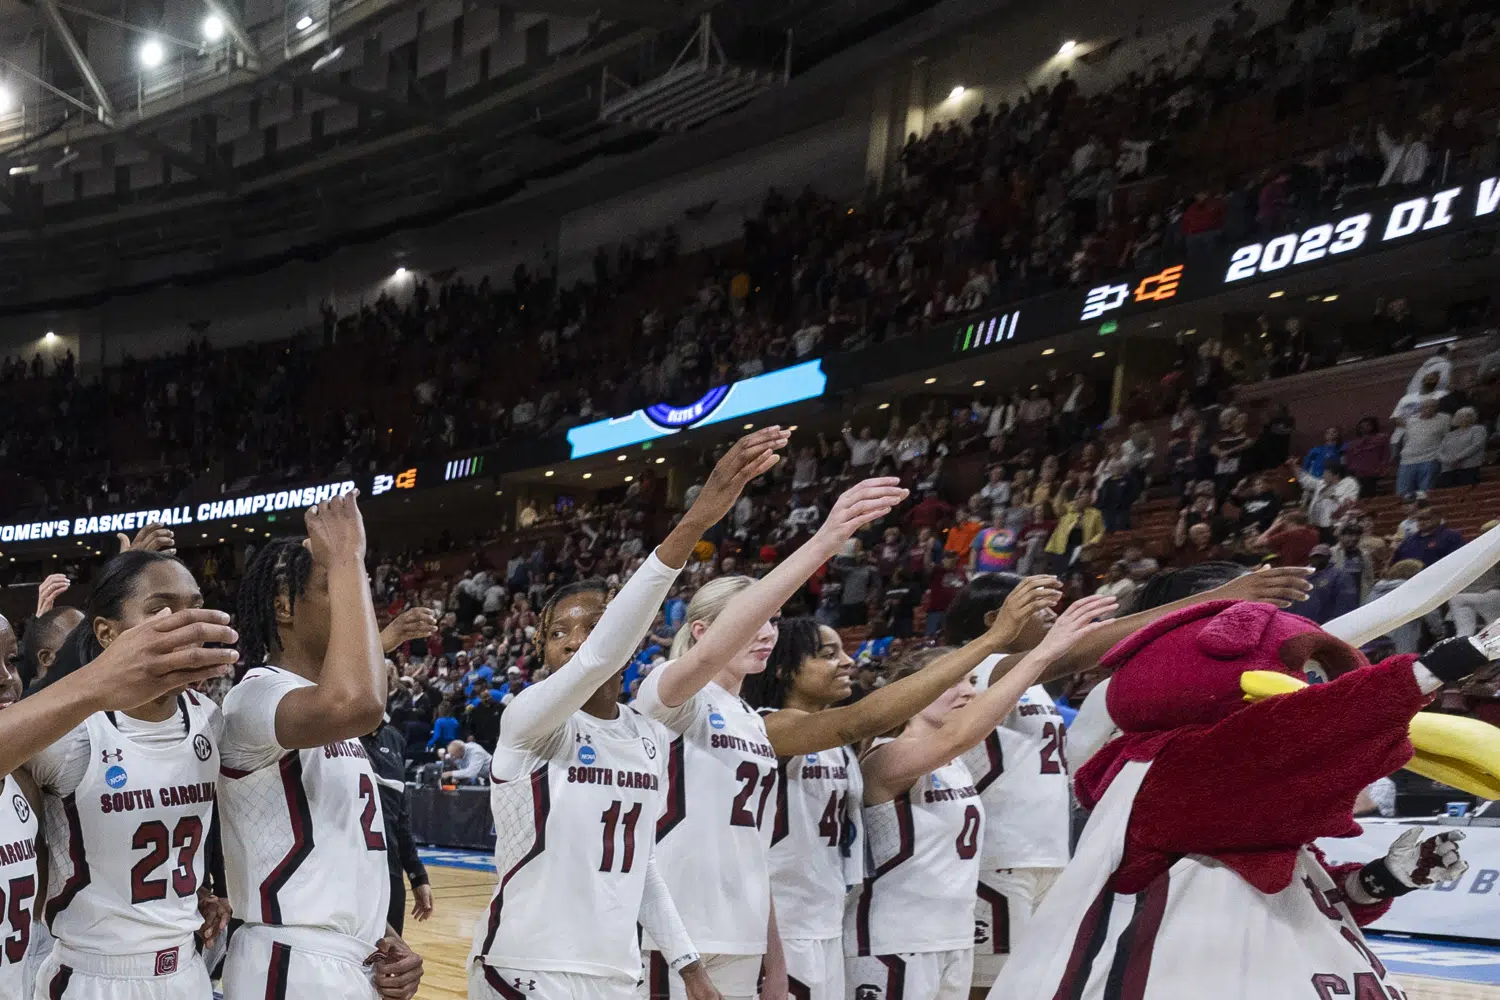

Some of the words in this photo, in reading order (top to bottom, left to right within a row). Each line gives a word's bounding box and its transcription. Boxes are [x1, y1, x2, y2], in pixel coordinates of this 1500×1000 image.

[1225, 211, 1372, 283] 2023
[1382, 186, 1462, 241] DI
[73, 505, 193, 535] BASKETBALL
[197, 480, 356, 521] CHAMPIONSHIP
[710, 733, 749, 753] SOUTH
[100, 788, 155, 814] SOUTH
[109, 773, 127, 785] NCAA
[567, 765, 613, 786] SOUTH
[730, 760, 777, 832] 21
[359, 772, 388, 851] 2
[598, 799, 643, 874] 11
[955, 804, 980, 860] 0
[131, 815, 203, 905] 23
